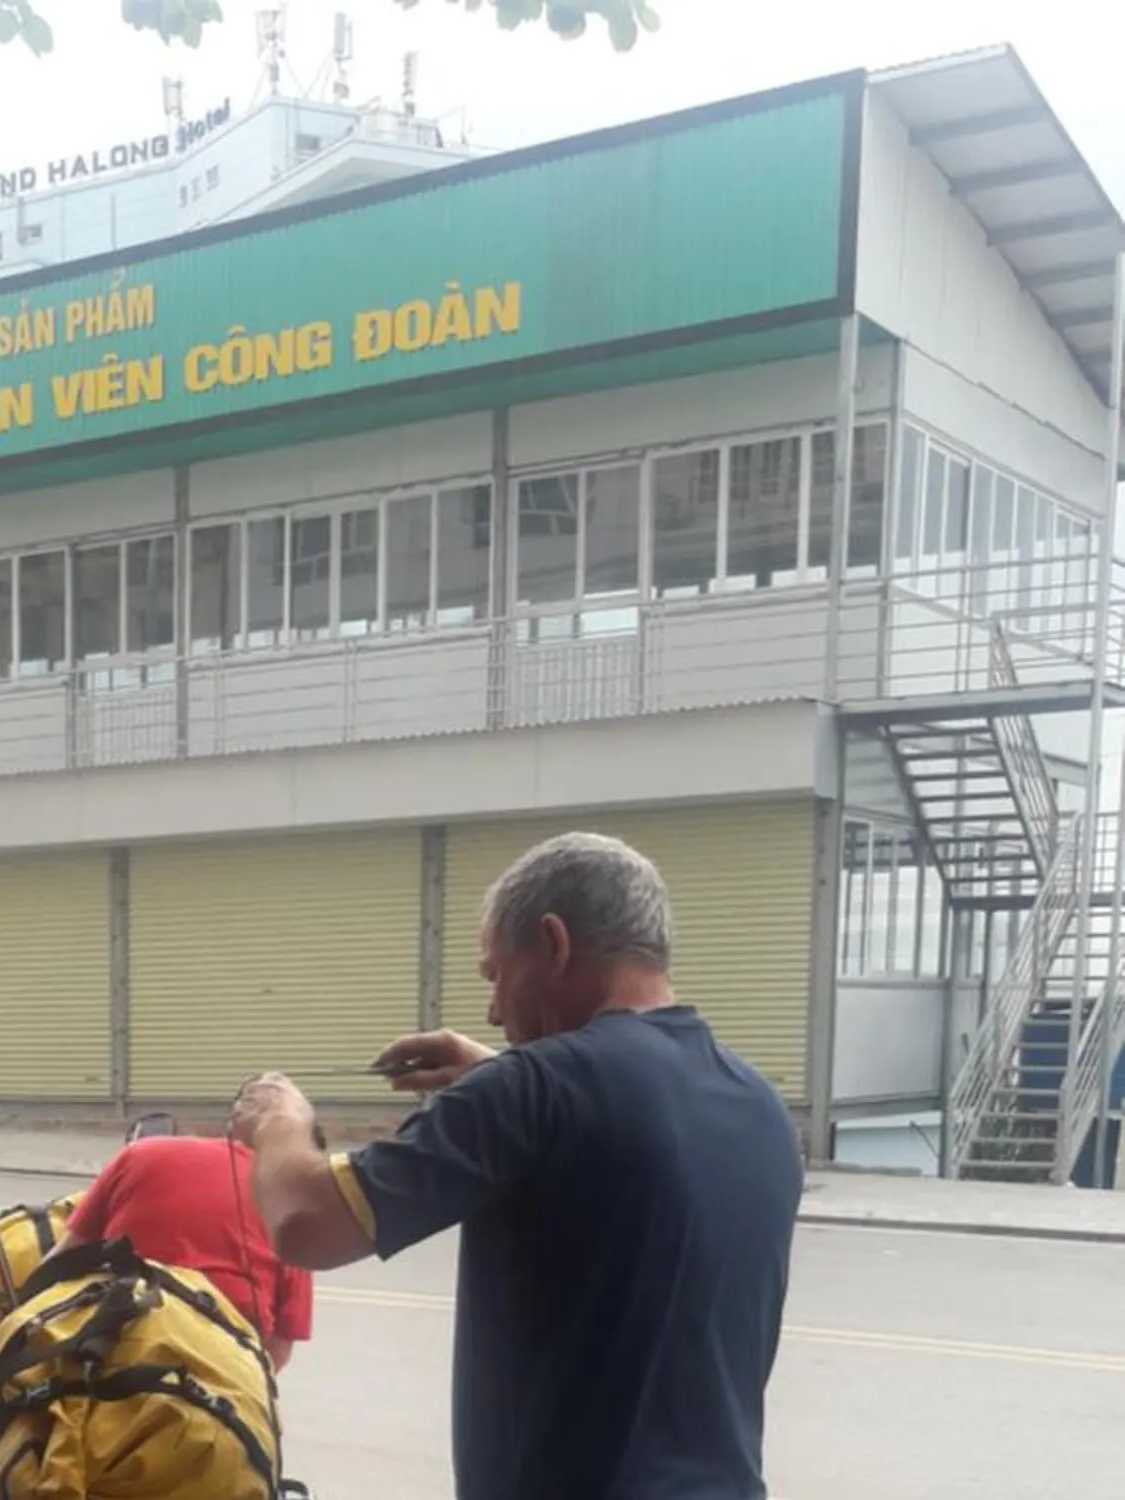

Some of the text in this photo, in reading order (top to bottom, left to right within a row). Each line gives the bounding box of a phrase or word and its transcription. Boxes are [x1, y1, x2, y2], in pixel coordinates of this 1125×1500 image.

[48, 134, 169, 184] HALONG
[51, 354, 164, 421] VIÊN
[184, 321, 333, 394] CÔNG
[351, 280, 523, 362] ĐOÀN
